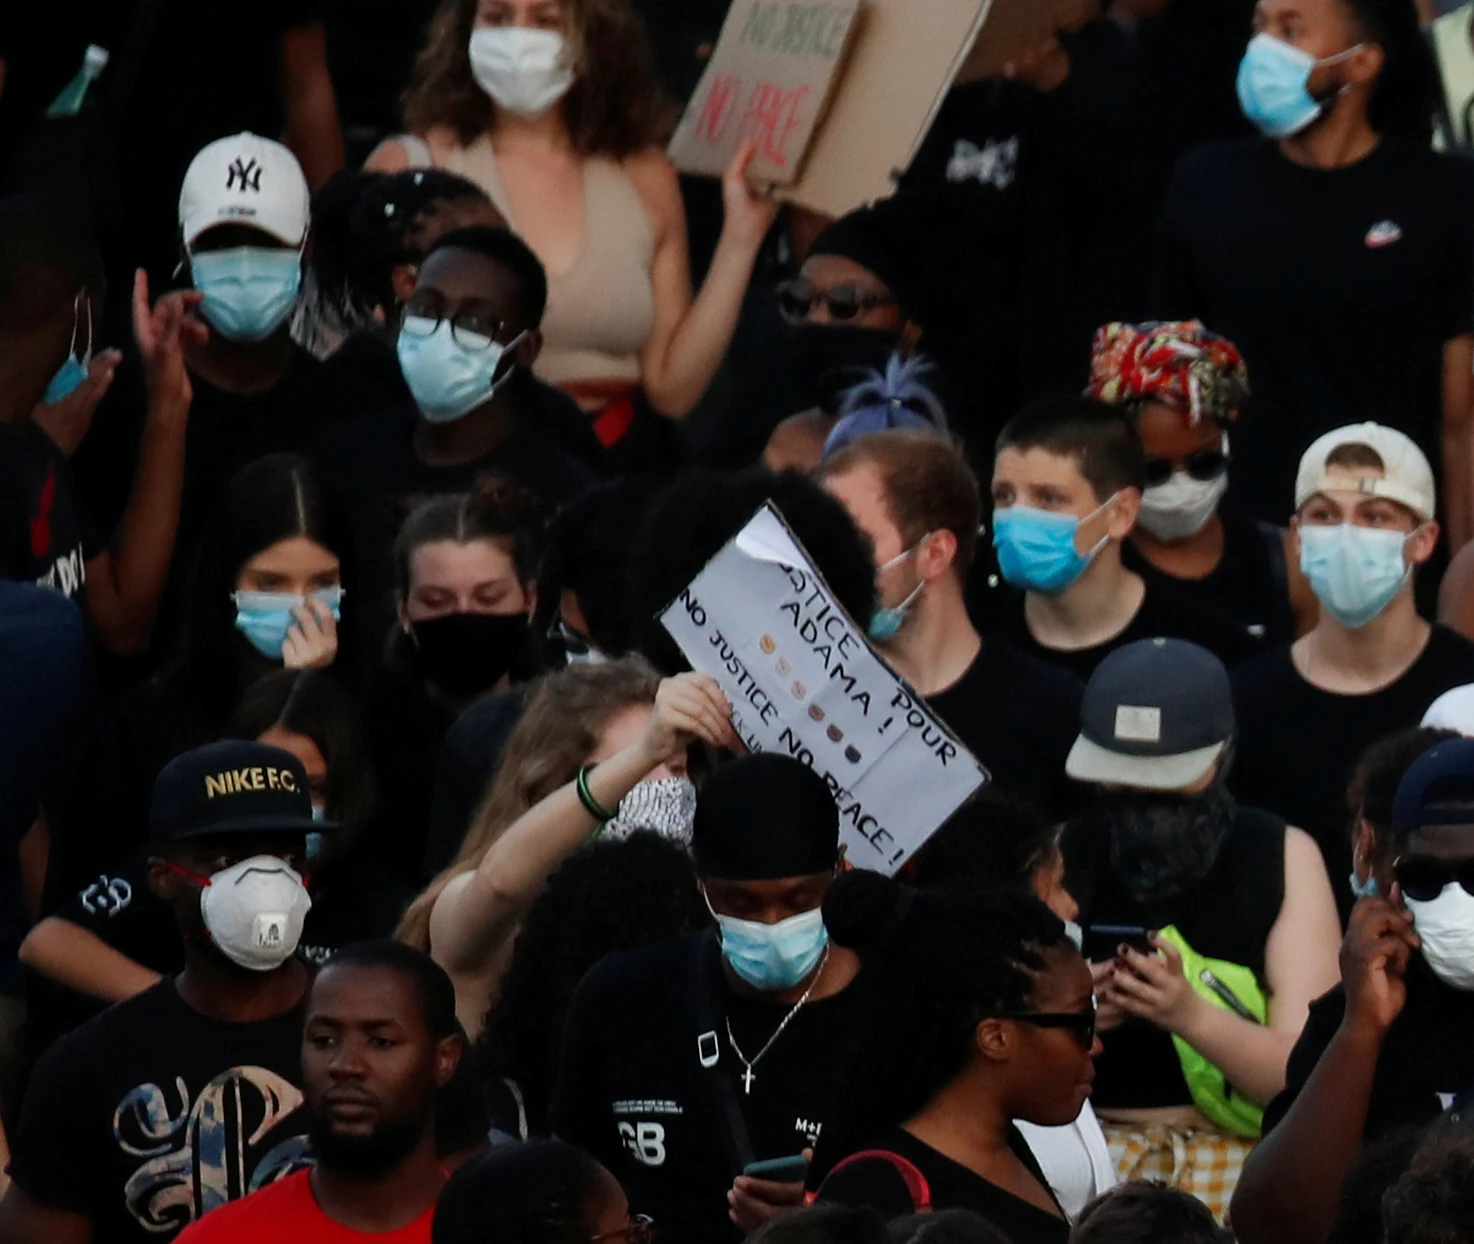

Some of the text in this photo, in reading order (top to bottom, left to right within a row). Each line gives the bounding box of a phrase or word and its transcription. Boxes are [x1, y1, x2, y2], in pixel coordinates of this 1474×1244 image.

[226, 155, 262, 192] NY
[781, 600, 873, 715] ADAMA
[678, 588, 707, 627] NO
[709, 632, 779, 727] JUSTICE
[779, 726, 815, 767] NO
[822, 770, 895, 854] PEACE
[890, 687, 957, 767] POUR
[205, 766, 301, 800] NIKE F.C.
